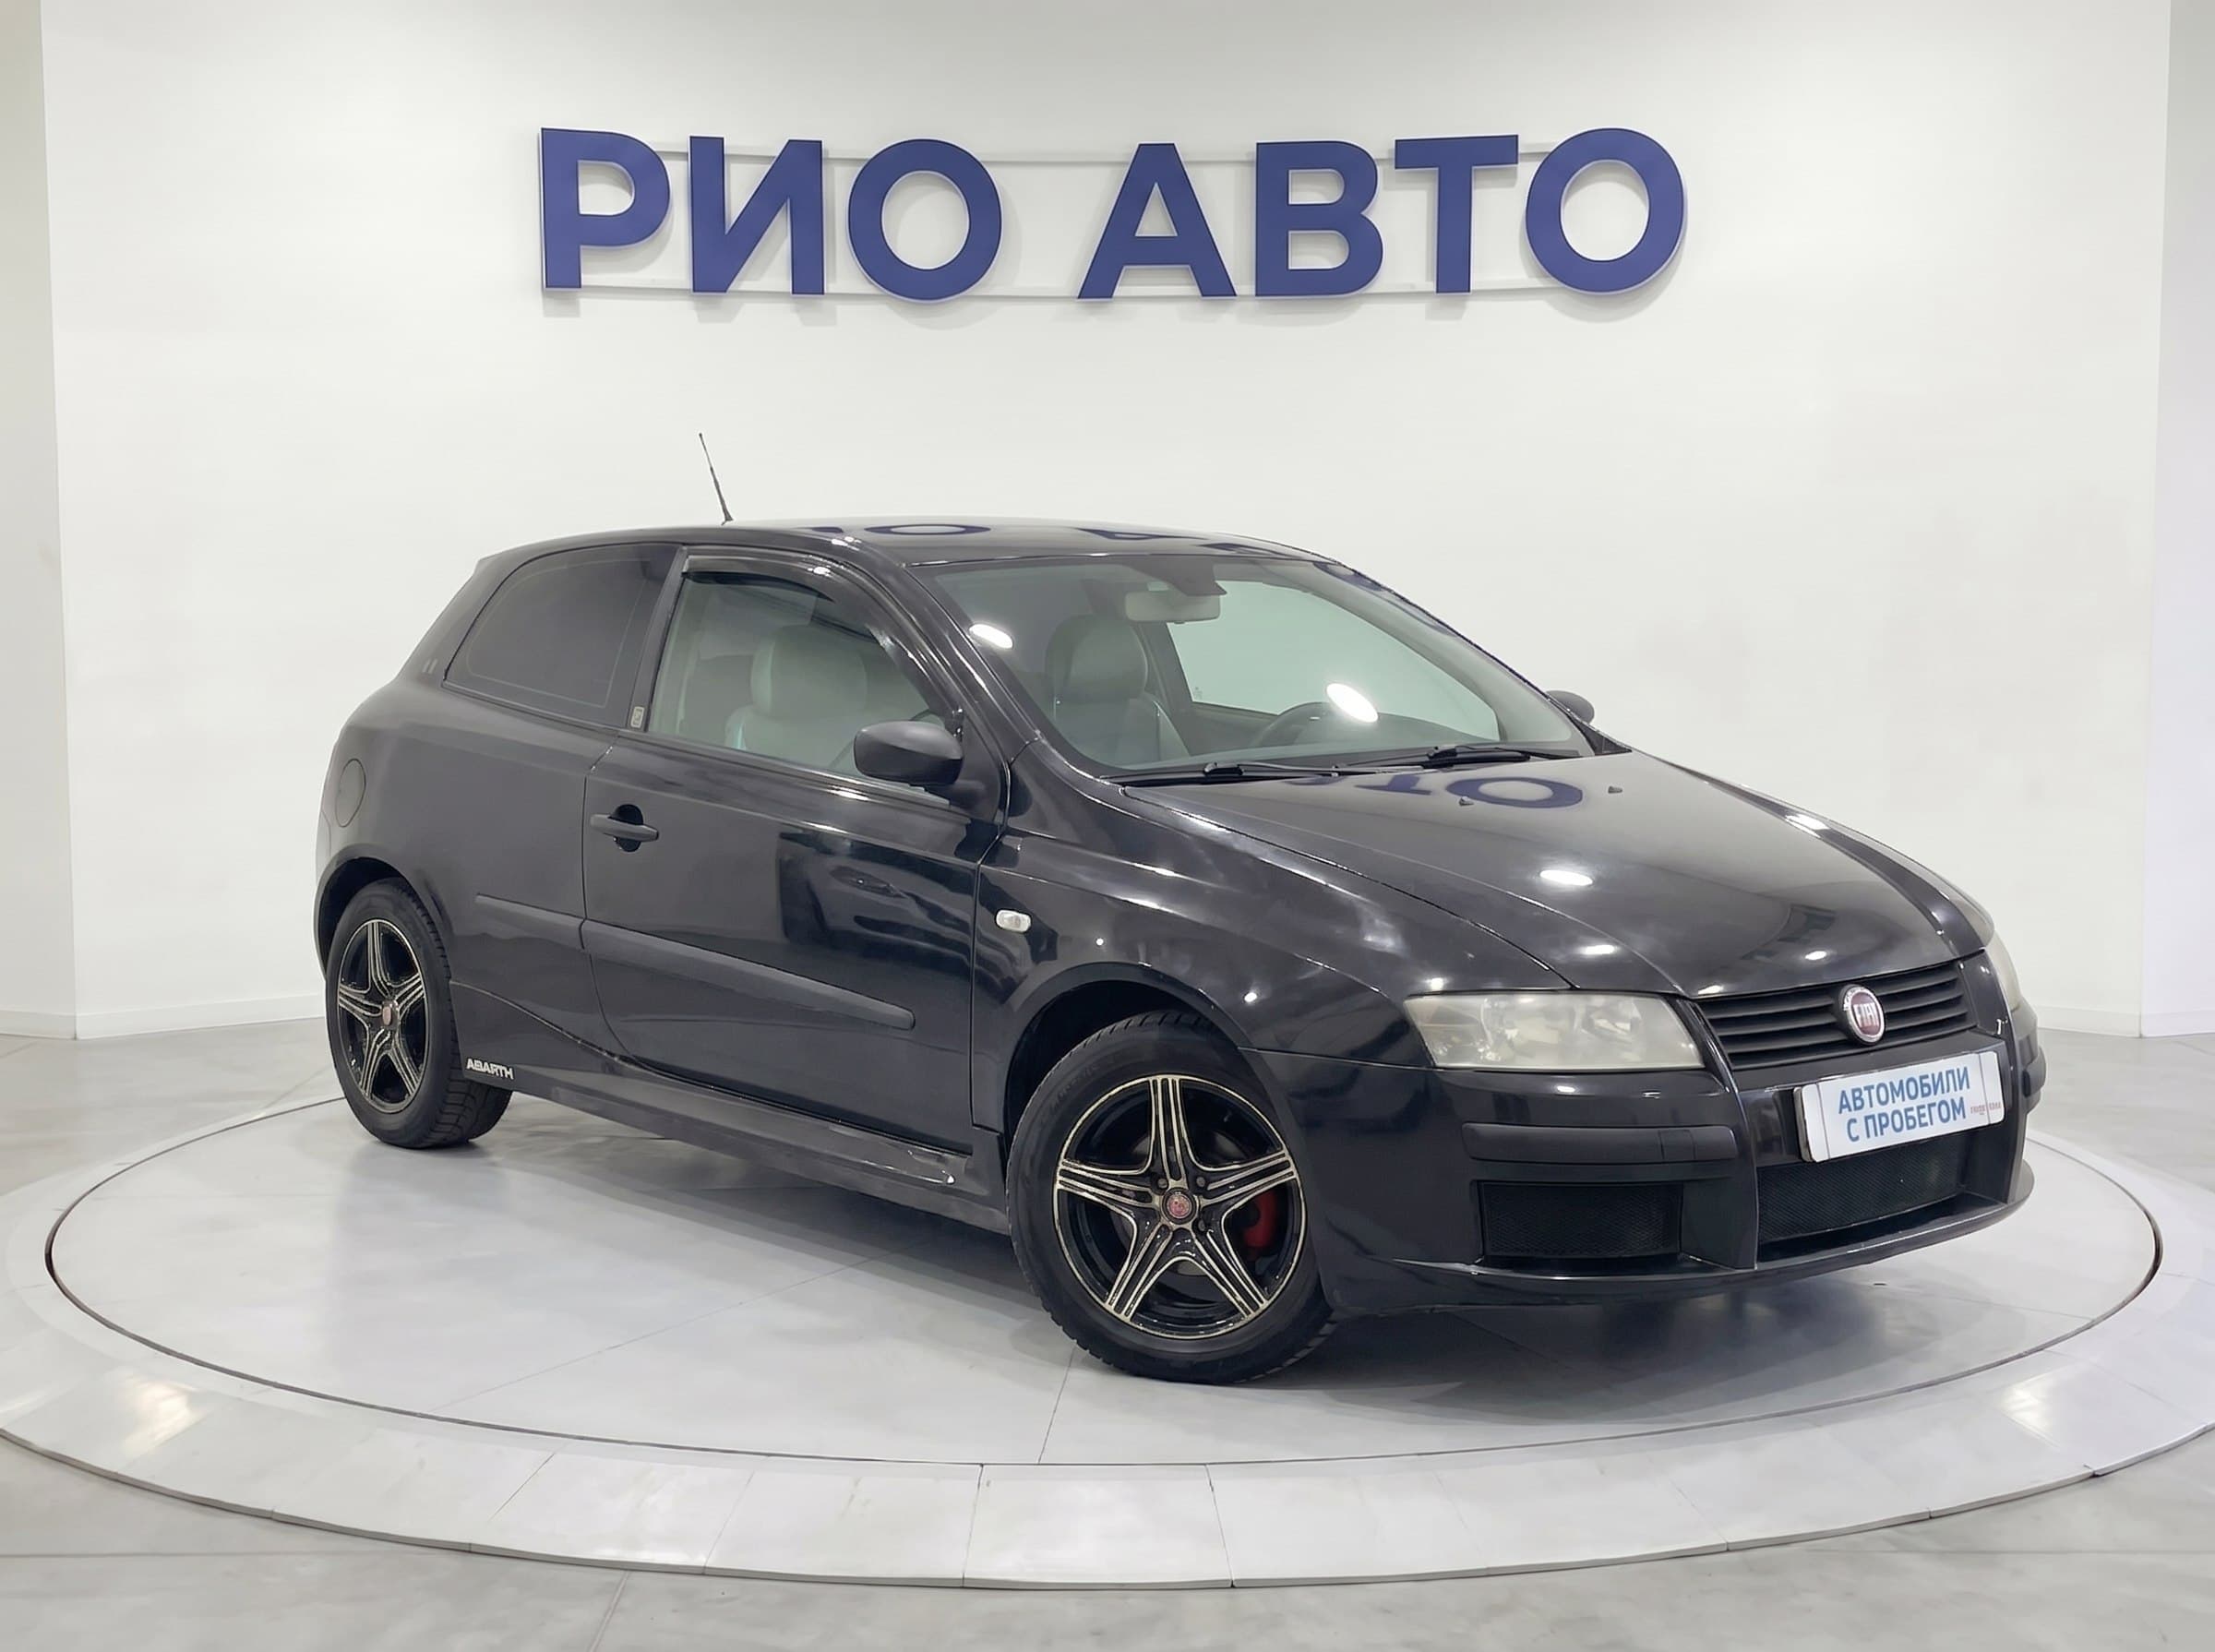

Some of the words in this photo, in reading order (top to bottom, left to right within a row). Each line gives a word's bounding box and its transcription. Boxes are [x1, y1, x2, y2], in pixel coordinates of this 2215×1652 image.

[540, 128, 1001, 301] РИО
[1078, 127, 1685, 298] АВТО
[466, 1058, 514, 1080] ABARTH
[1838, 1066, 1970, 1114] АВТОМОБИЛИ
[1847, 1117, 1860, 1143] С
[1864, 1096, 1967, 1140] ПРОБЕГОМ
